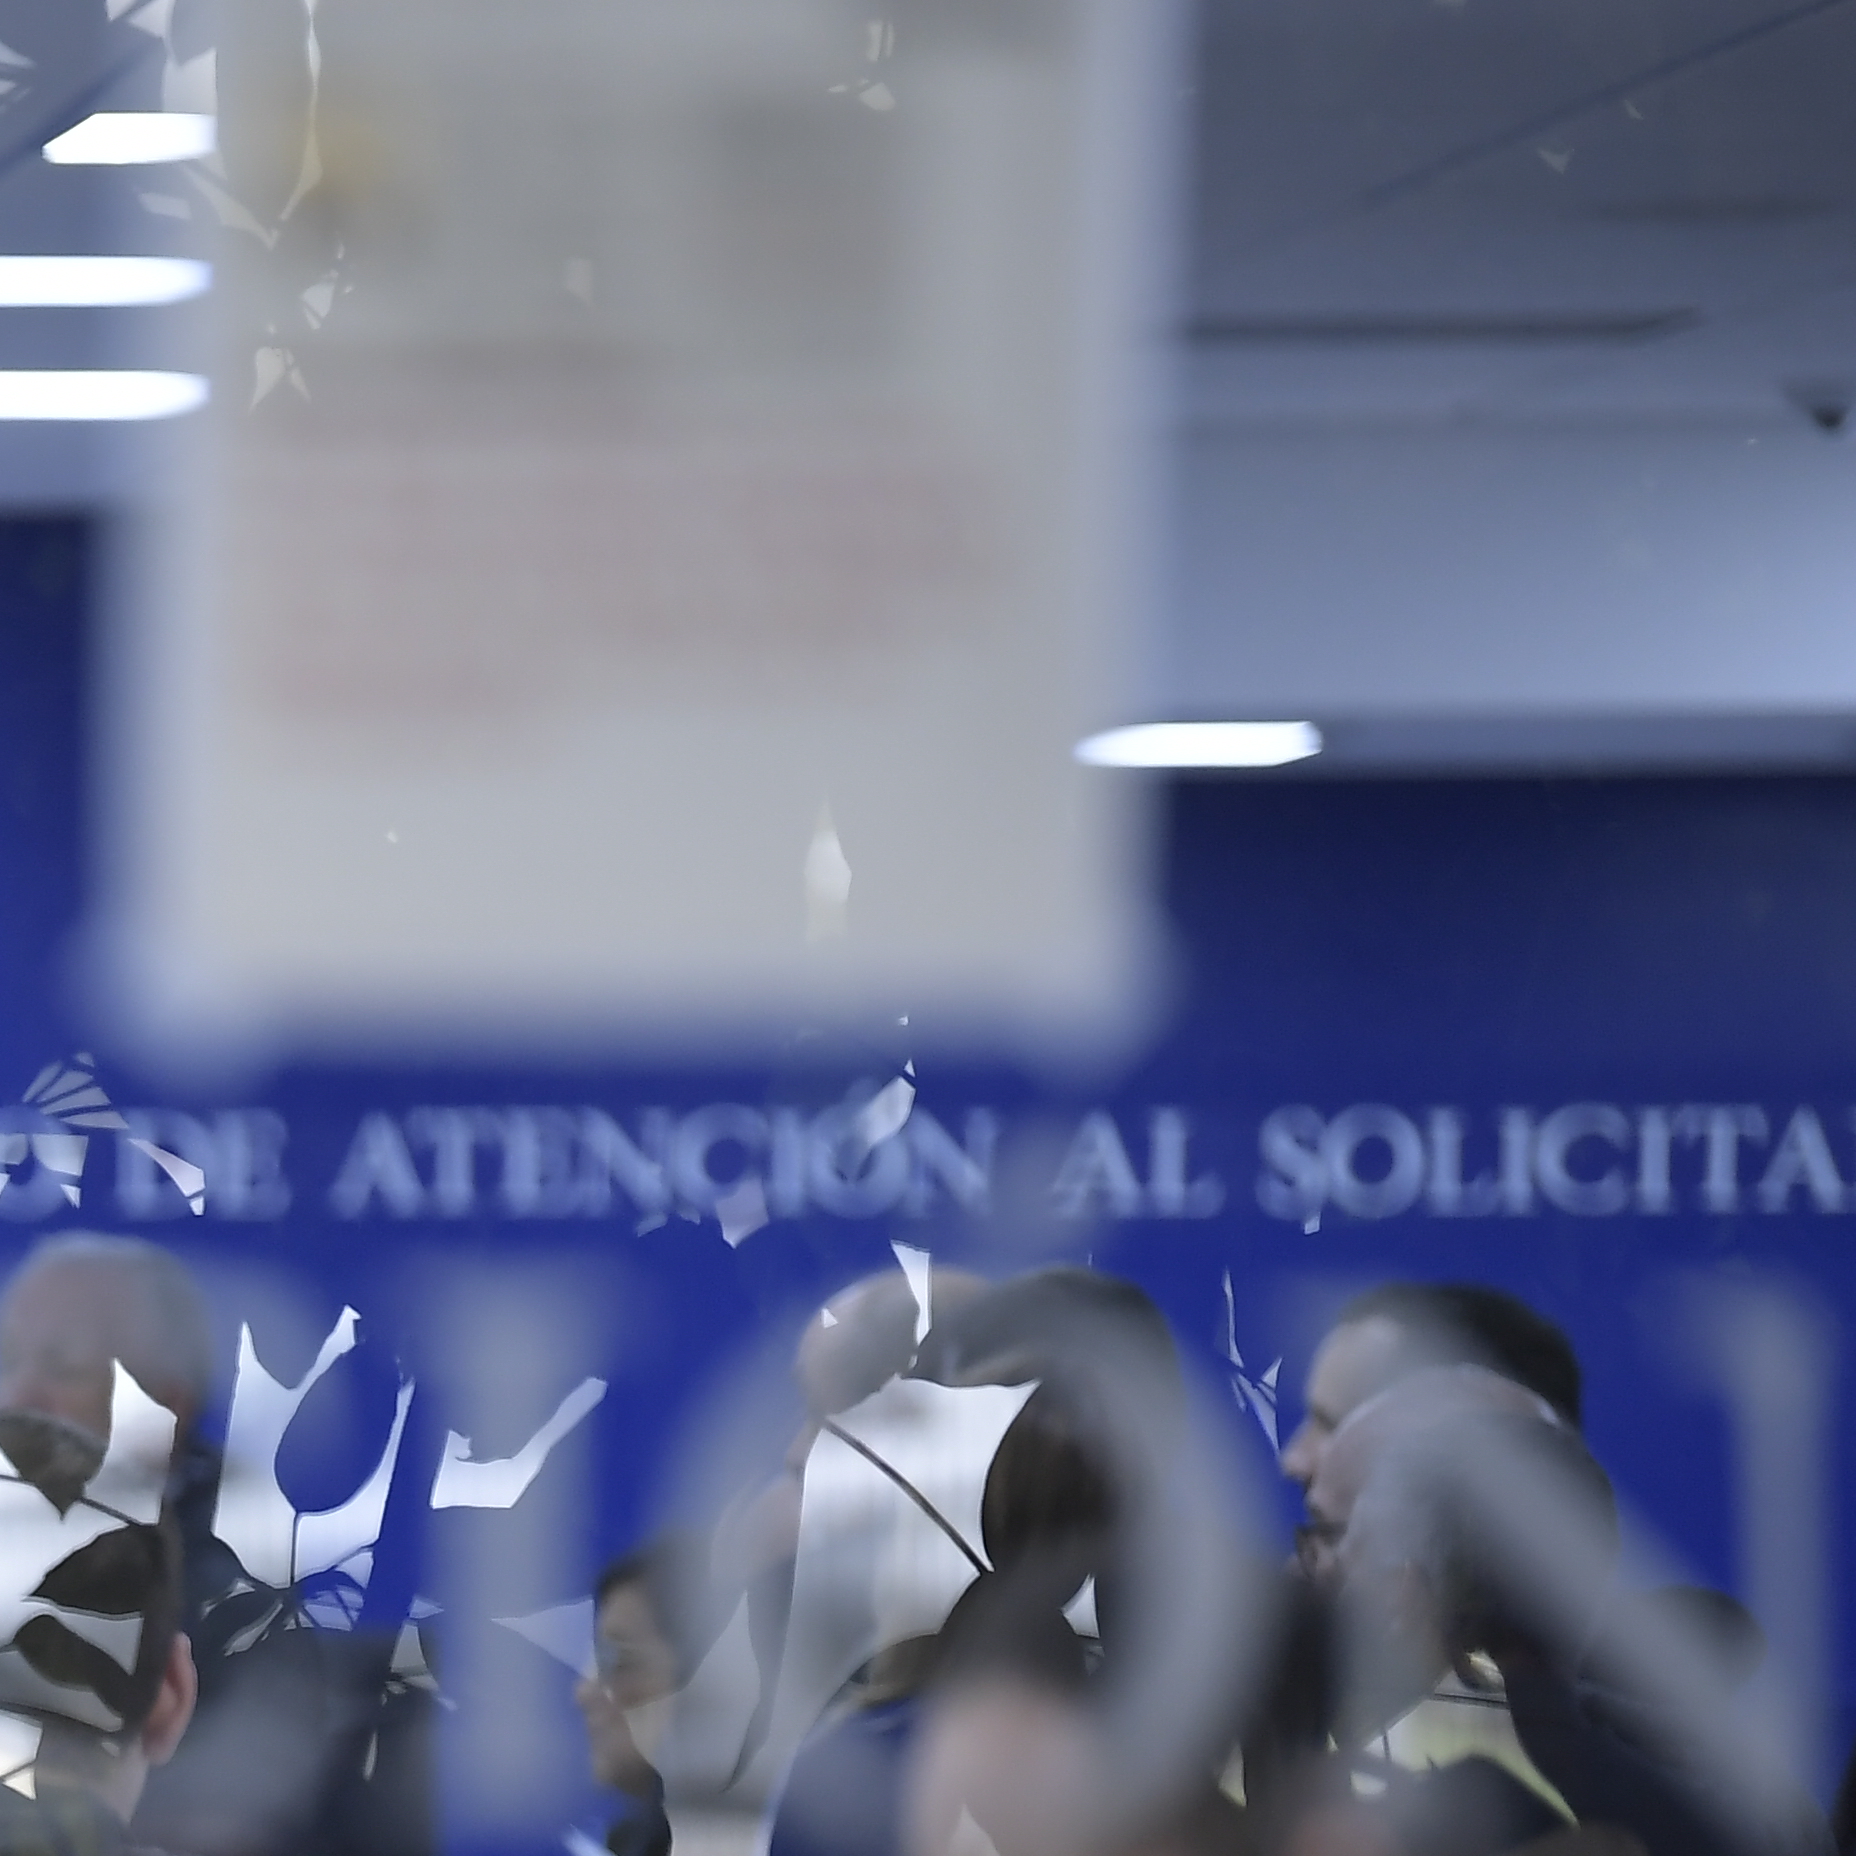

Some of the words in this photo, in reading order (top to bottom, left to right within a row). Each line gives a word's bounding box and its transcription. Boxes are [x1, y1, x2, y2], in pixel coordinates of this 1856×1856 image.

[113, 1104, 290, 1222] DE
[1052, 1102, 1226, 1222] AL
[1256, 1102, 1856, 1222] SOLICITA
